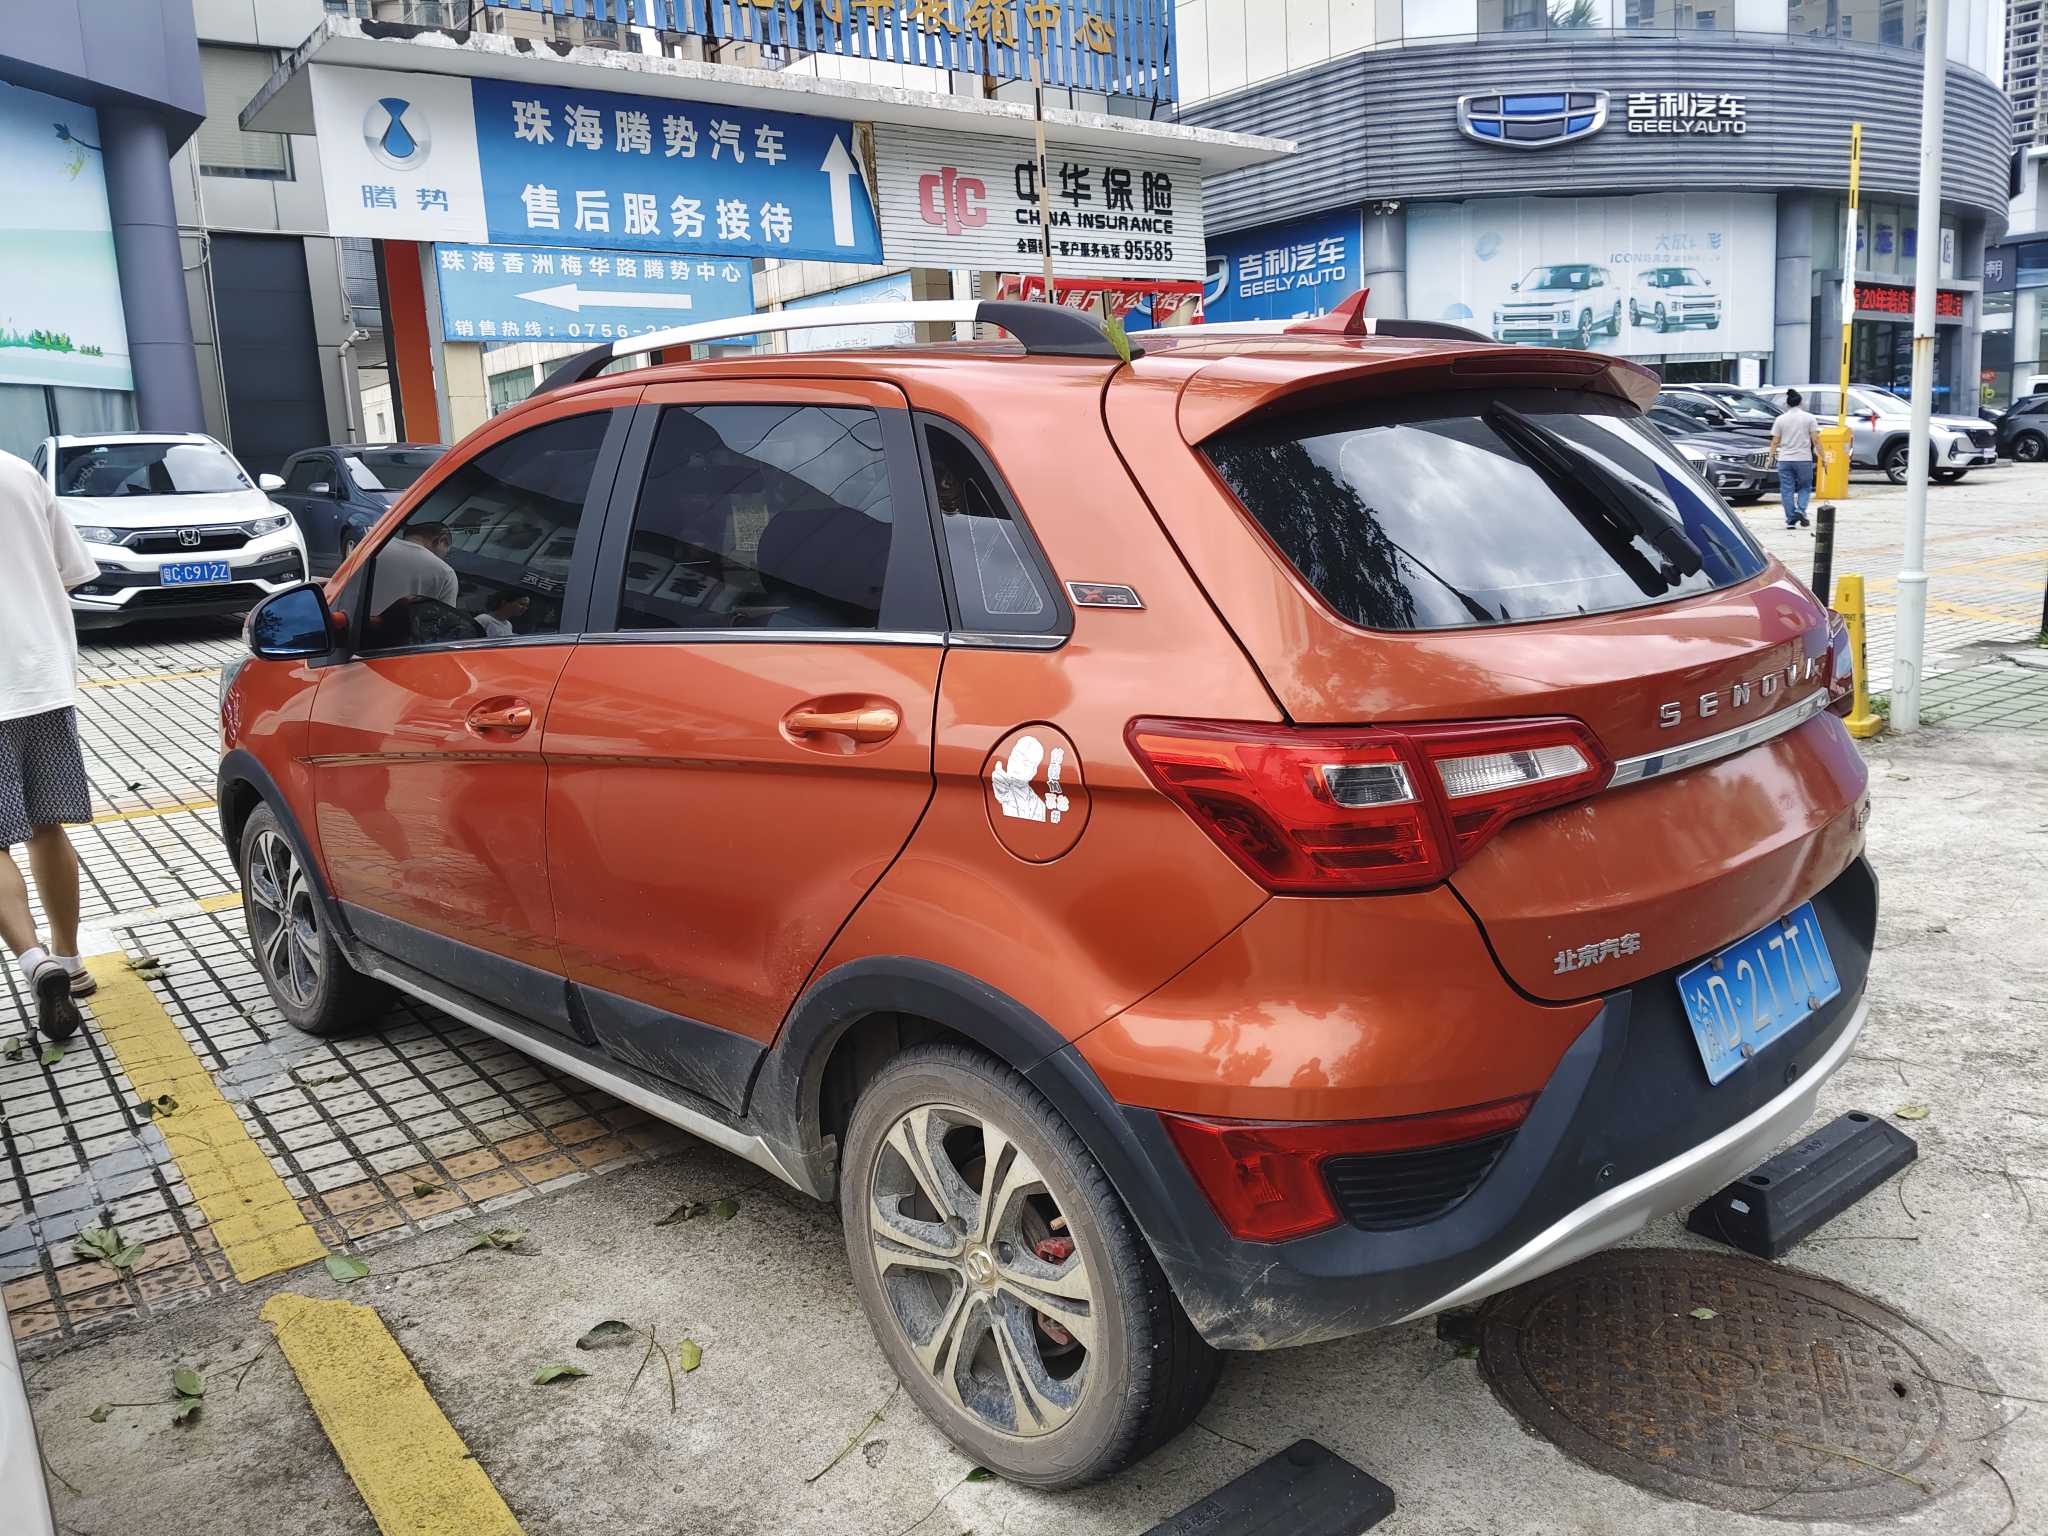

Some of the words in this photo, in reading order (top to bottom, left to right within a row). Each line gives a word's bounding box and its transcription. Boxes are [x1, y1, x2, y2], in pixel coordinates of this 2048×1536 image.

[1628, 92, 1746, 118] 吉利汽车
[512, 100, 788, 167] 珠海腾势汽车
[361, 184, 449, 212] 腾势
[1015, 160, 1174, 216] 中华保险
[521, 184, 794, 245] 售后服务接待
[1015, 208, 1071, 228] CHNA
[1077, 212, 1174, 235] INSURANCE
[441, 250, 742, 283] 珠海香洲梅华路腾势中心
[1124, 240, 1173, 262] 95585
[1239, 236, 1345, 282] 吉利汽车
[1552, 932, 1641, 977] 北京汽车
